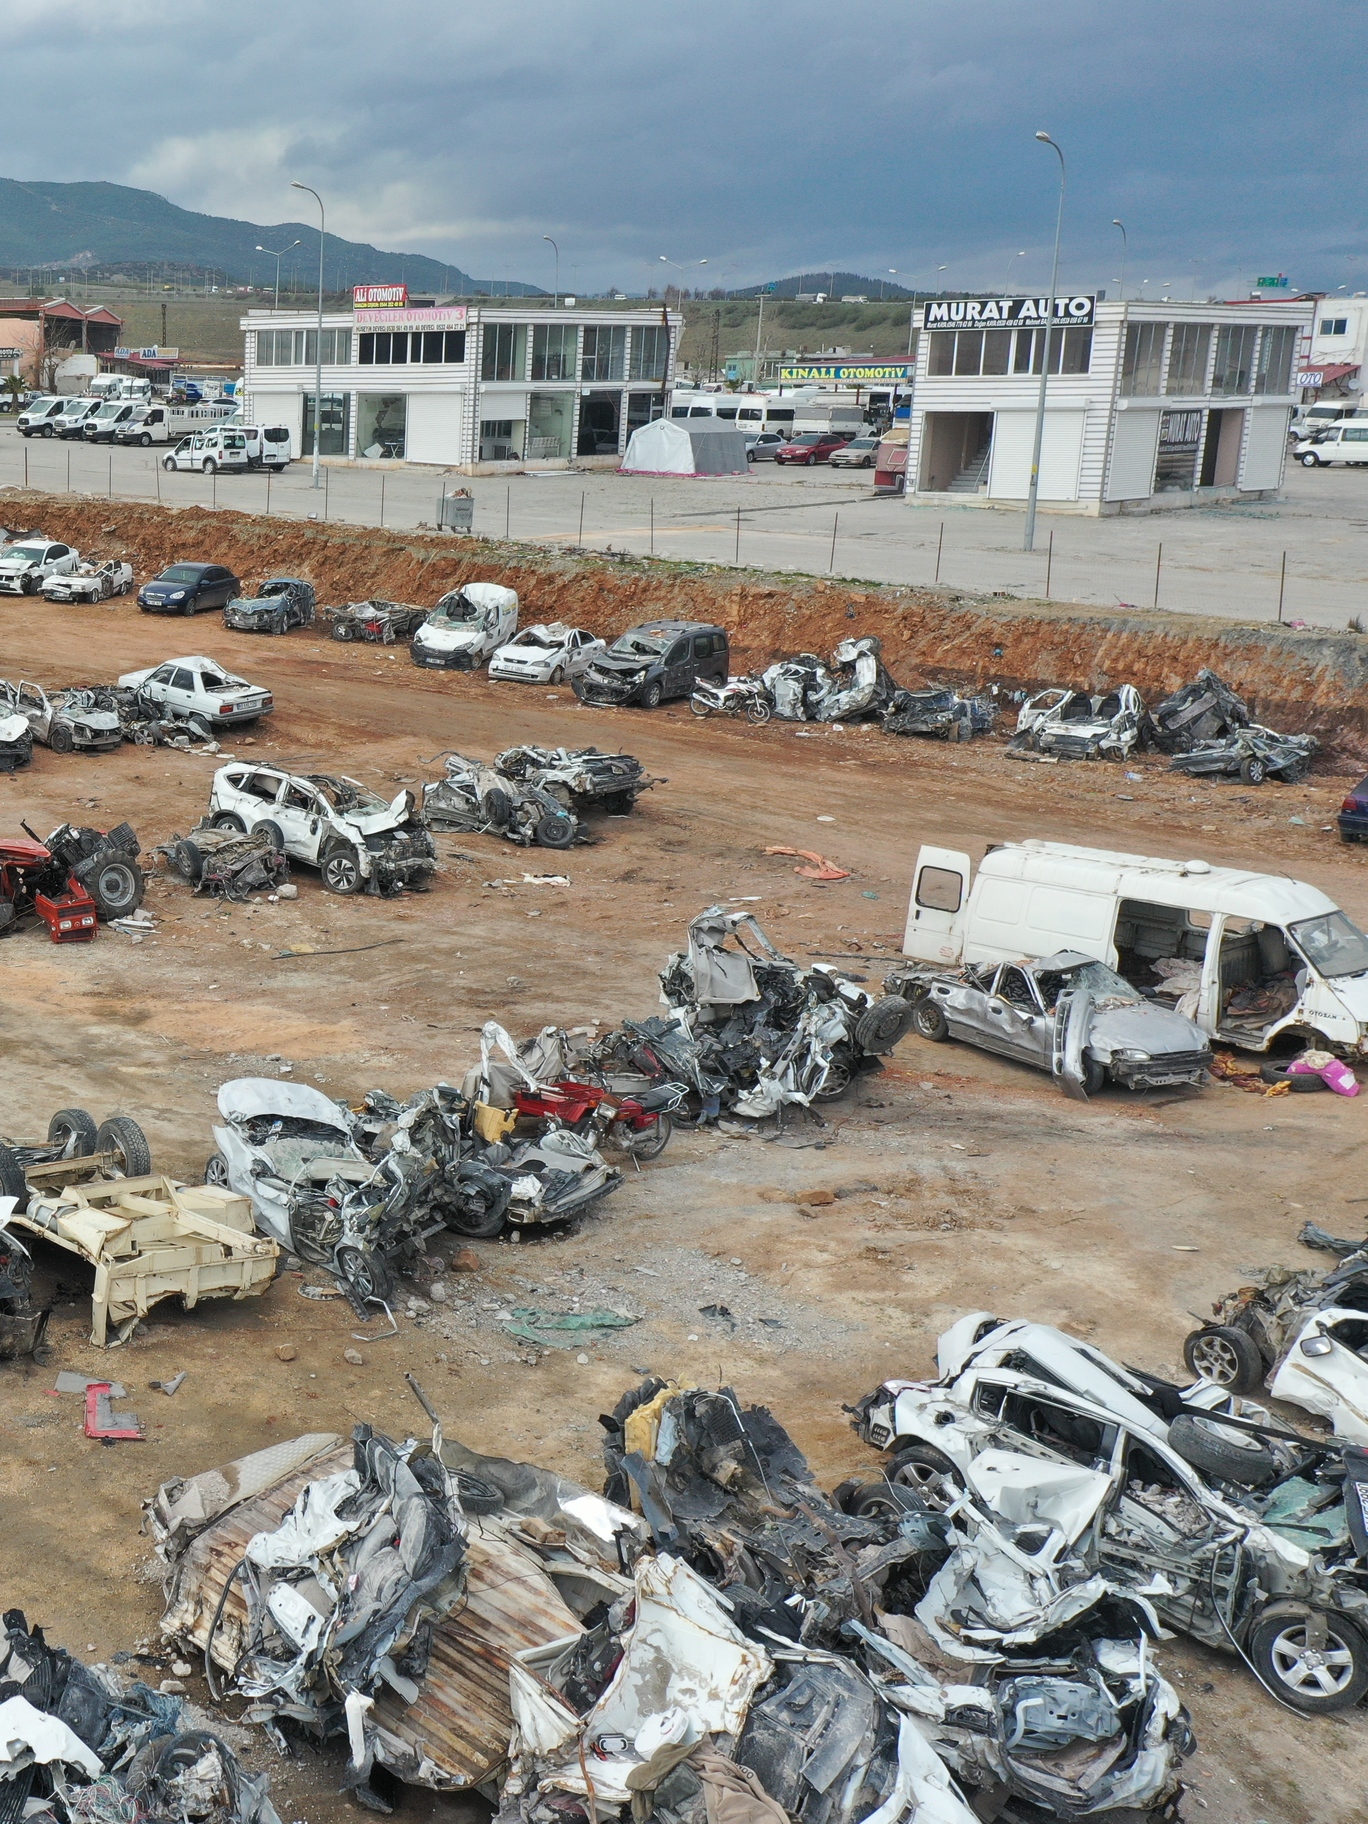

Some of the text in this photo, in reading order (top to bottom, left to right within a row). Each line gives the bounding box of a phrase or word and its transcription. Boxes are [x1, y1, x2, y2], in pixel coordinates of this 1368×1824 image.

[456, 308, 464, 320] 3
[928, 297, 1092, 321] MURAT AUTO
[142, 349, 156, 358] ADA
[780, 368, 836, 379] KINALI
[1300, 373, 1322, 383] OTO
[1309, 1010, 1337, 1019] OTOSAN
